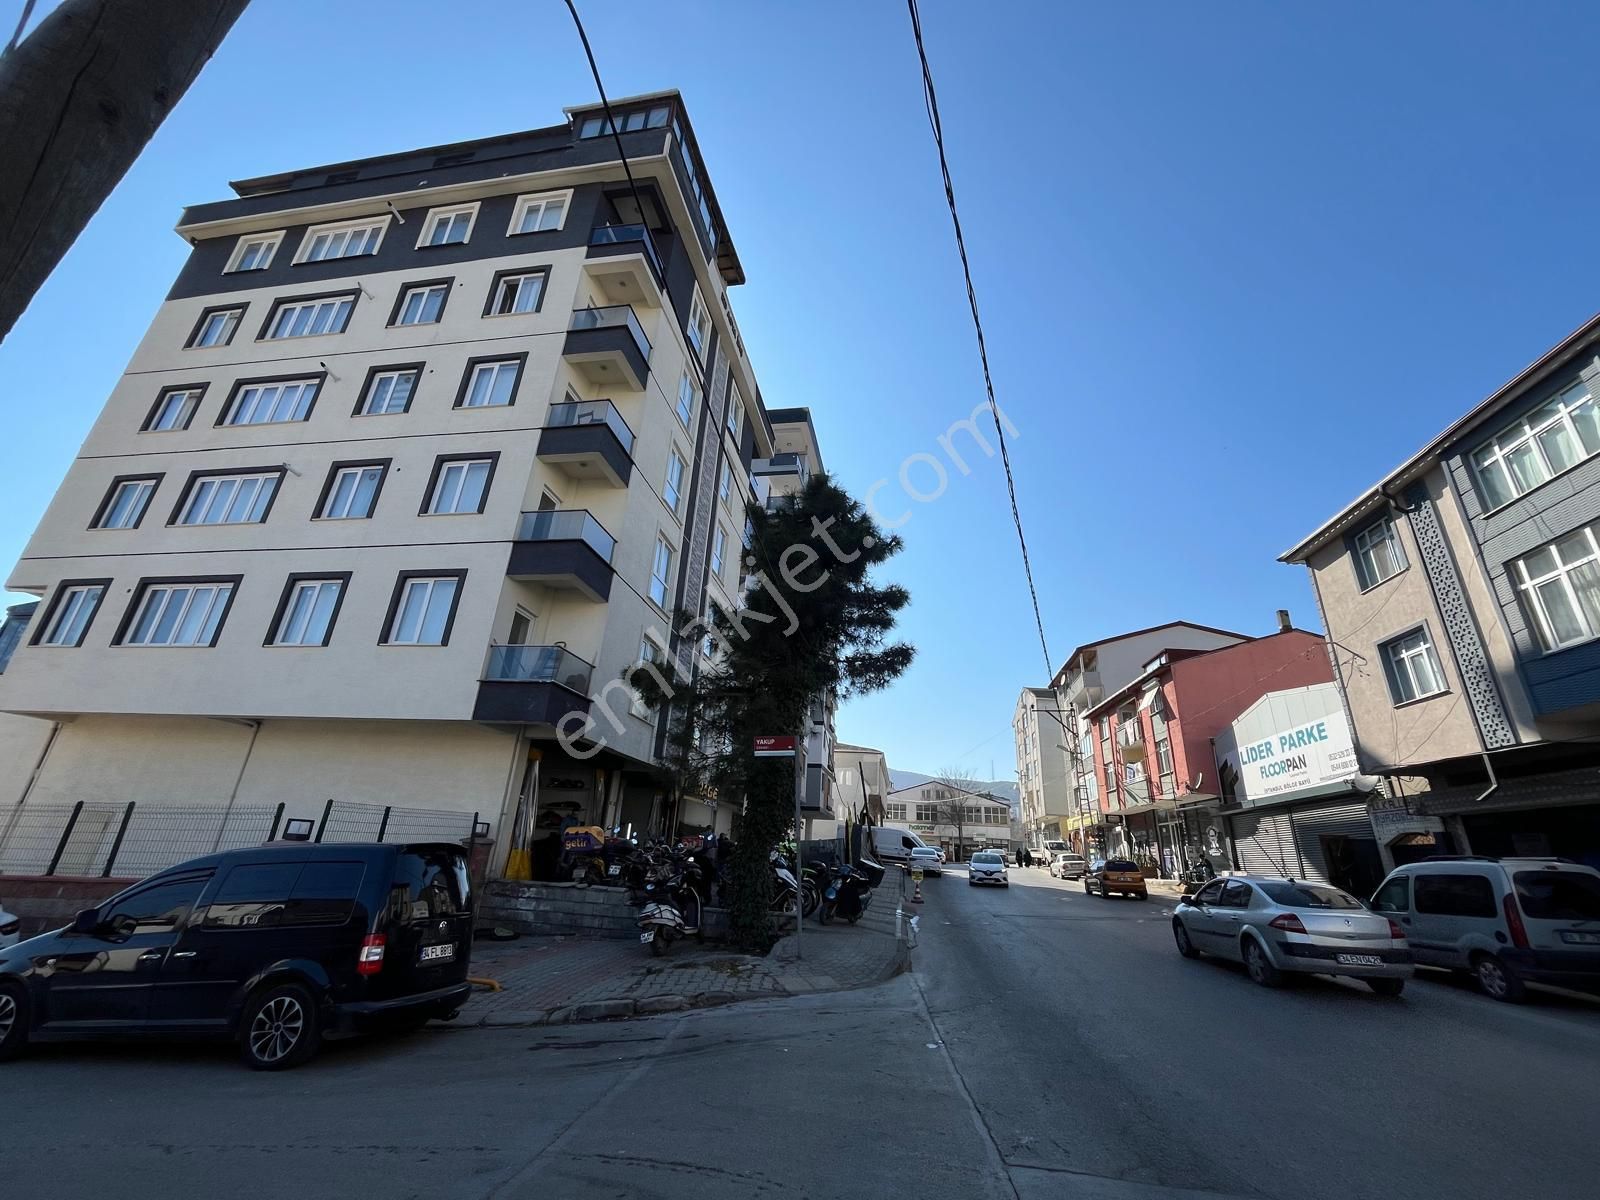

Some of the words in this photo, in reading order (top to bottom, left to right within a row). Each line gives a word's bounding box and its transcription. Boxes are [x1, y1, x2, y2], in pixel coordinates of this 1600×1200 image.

[1240, 740, 1274, 765] LİDER
[1279, 722, 1328, 753] PARKE
[1260, 754, 1307, 779] FLOORPAN
[565, 839, 587, 849] getir
